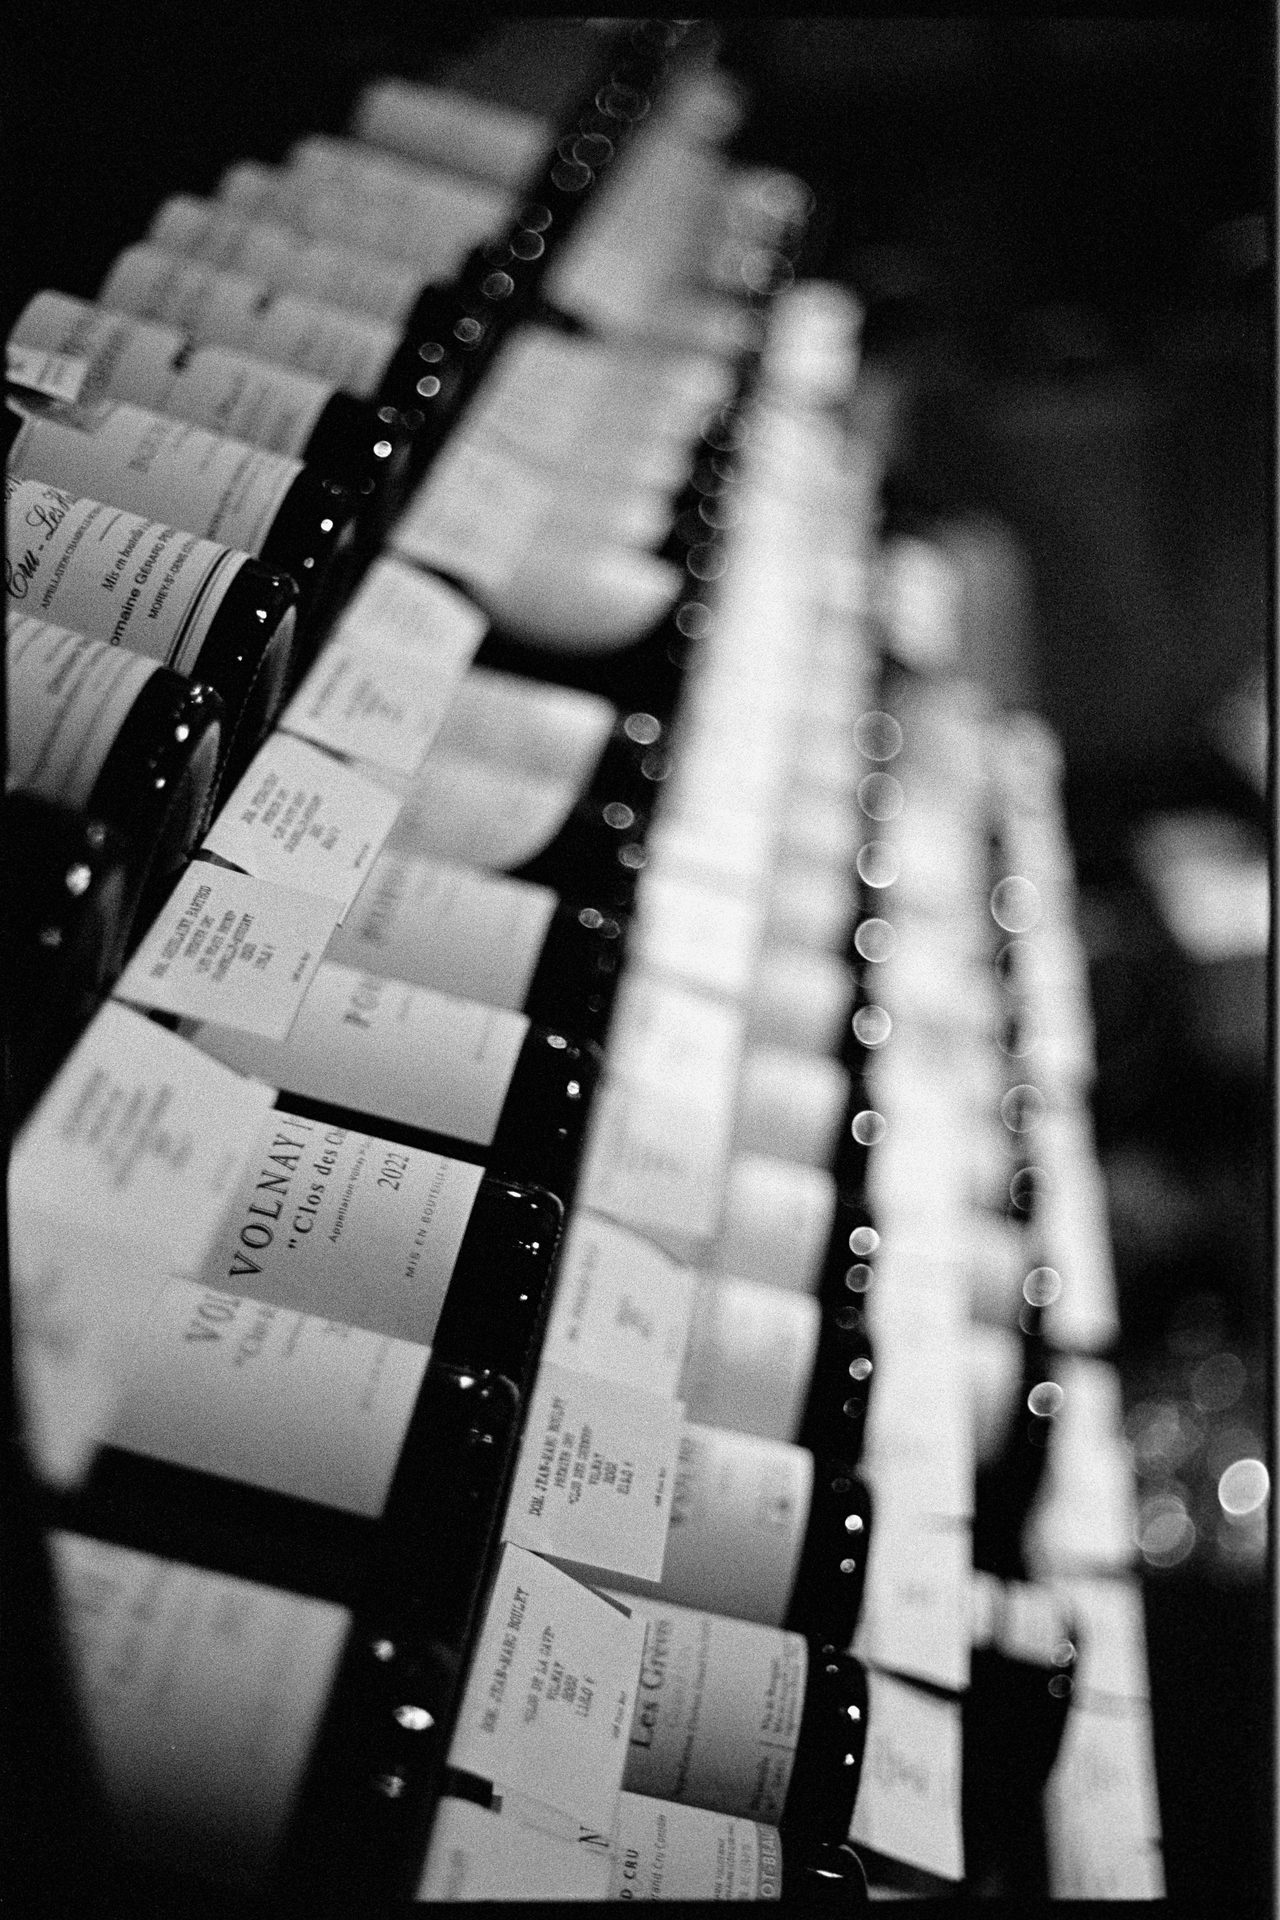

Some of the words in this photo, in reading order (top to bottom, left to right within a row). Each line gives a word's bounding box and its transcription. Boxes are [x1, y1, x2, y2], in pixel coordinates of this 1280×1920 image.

[25, 505, 65, 541] Les
[101, 571, 119, 591] Mis
[115, 558, 127, 571] en
[109, 588, 140, 646] omaine
[313, 1150, 337, 1176] des
[377, 1153, 409, 1191] 2022
[229, 1134, 305, 1276] VOLNAY
[328, 1184, 354, 1243] Appellation
[623, 1849, 639, 1880] CRU
[649, 1872, 663, 1899] rand
